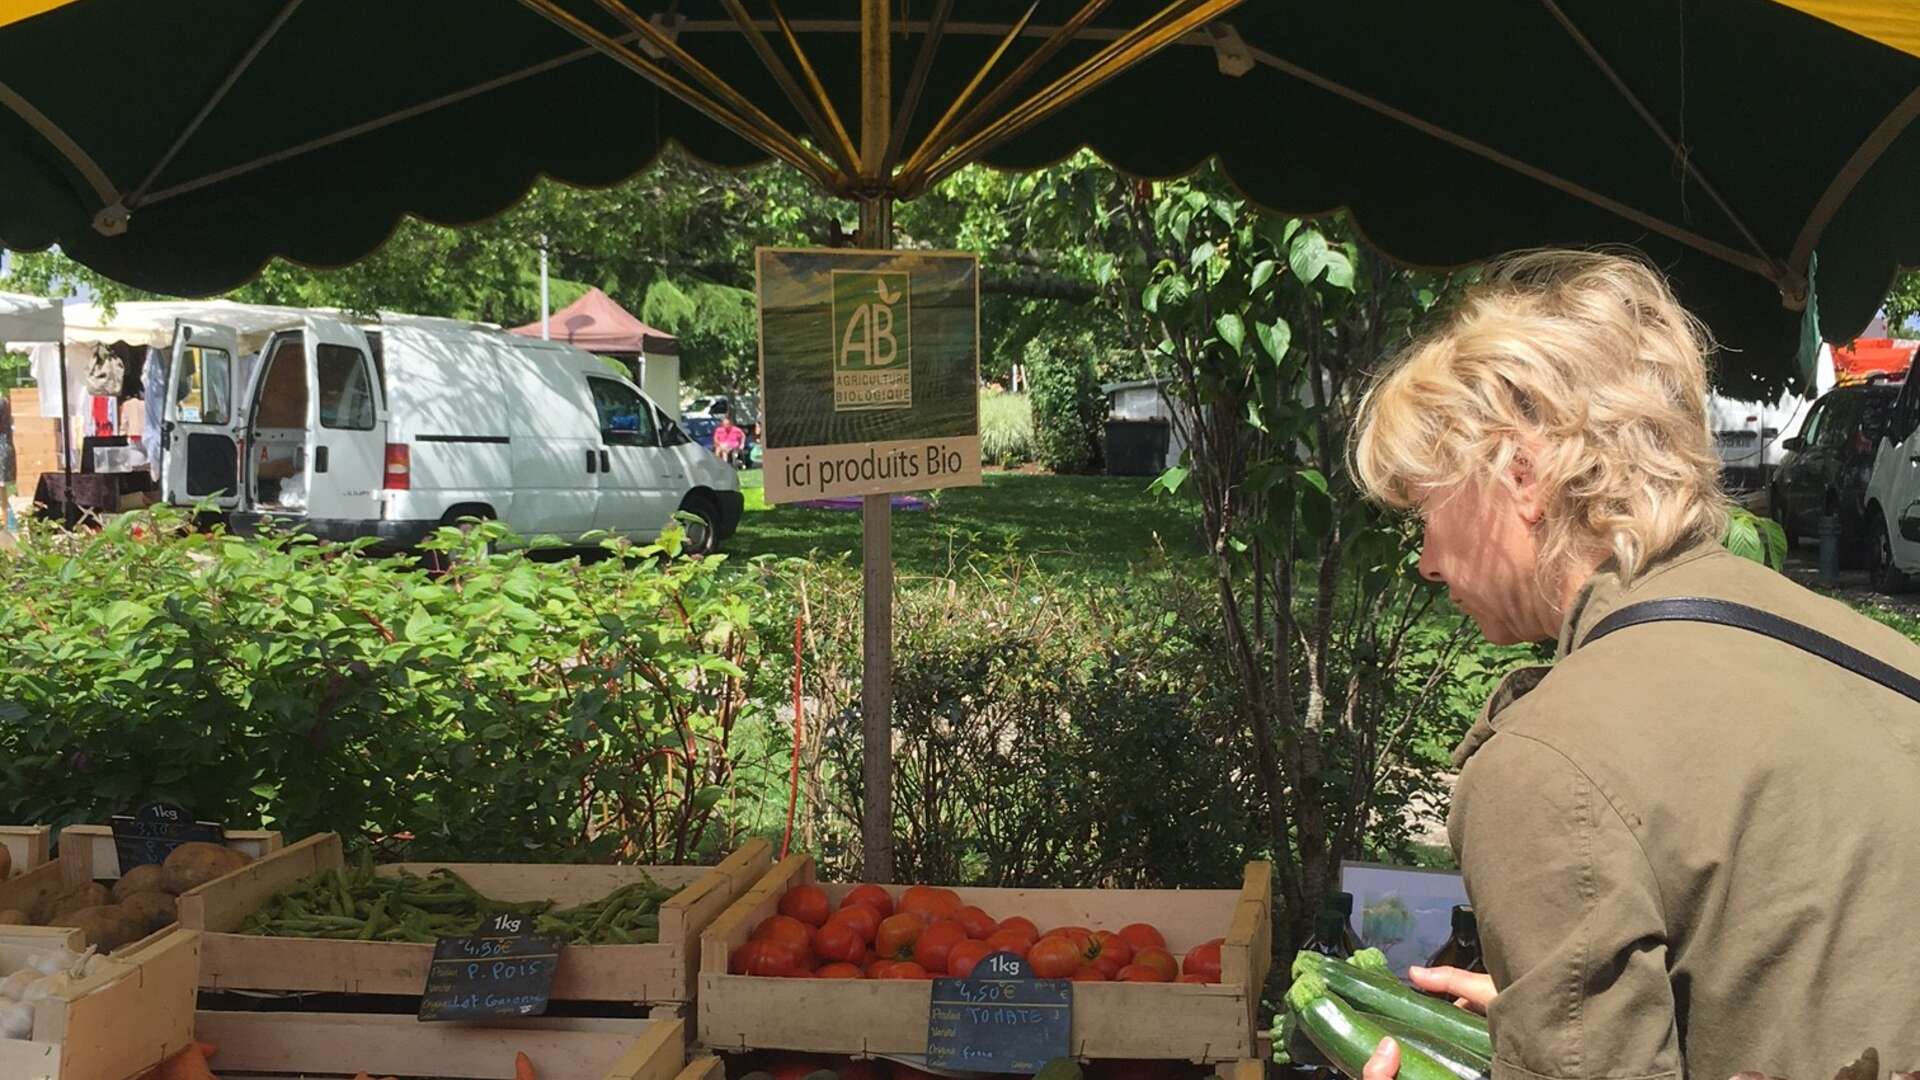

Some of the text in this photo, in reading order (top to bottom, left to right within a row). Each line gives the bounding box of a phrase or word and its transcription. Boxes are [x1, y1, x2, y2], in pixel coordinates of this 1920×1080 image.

[840, 303, 897, 366] AB
[835, 374, 909, 387] AGRICULTURE
[836, 388, 910, 402] BIOLOGIQUE
[785, 445, 962, 493] ici produits Bio
[152, 805, 178, 820] 1kg
[494, 914, 521, 932] 1kg
[990, 955, 1020, 975] 1kg
[959, 983, 1017, 1002] 4,50€
